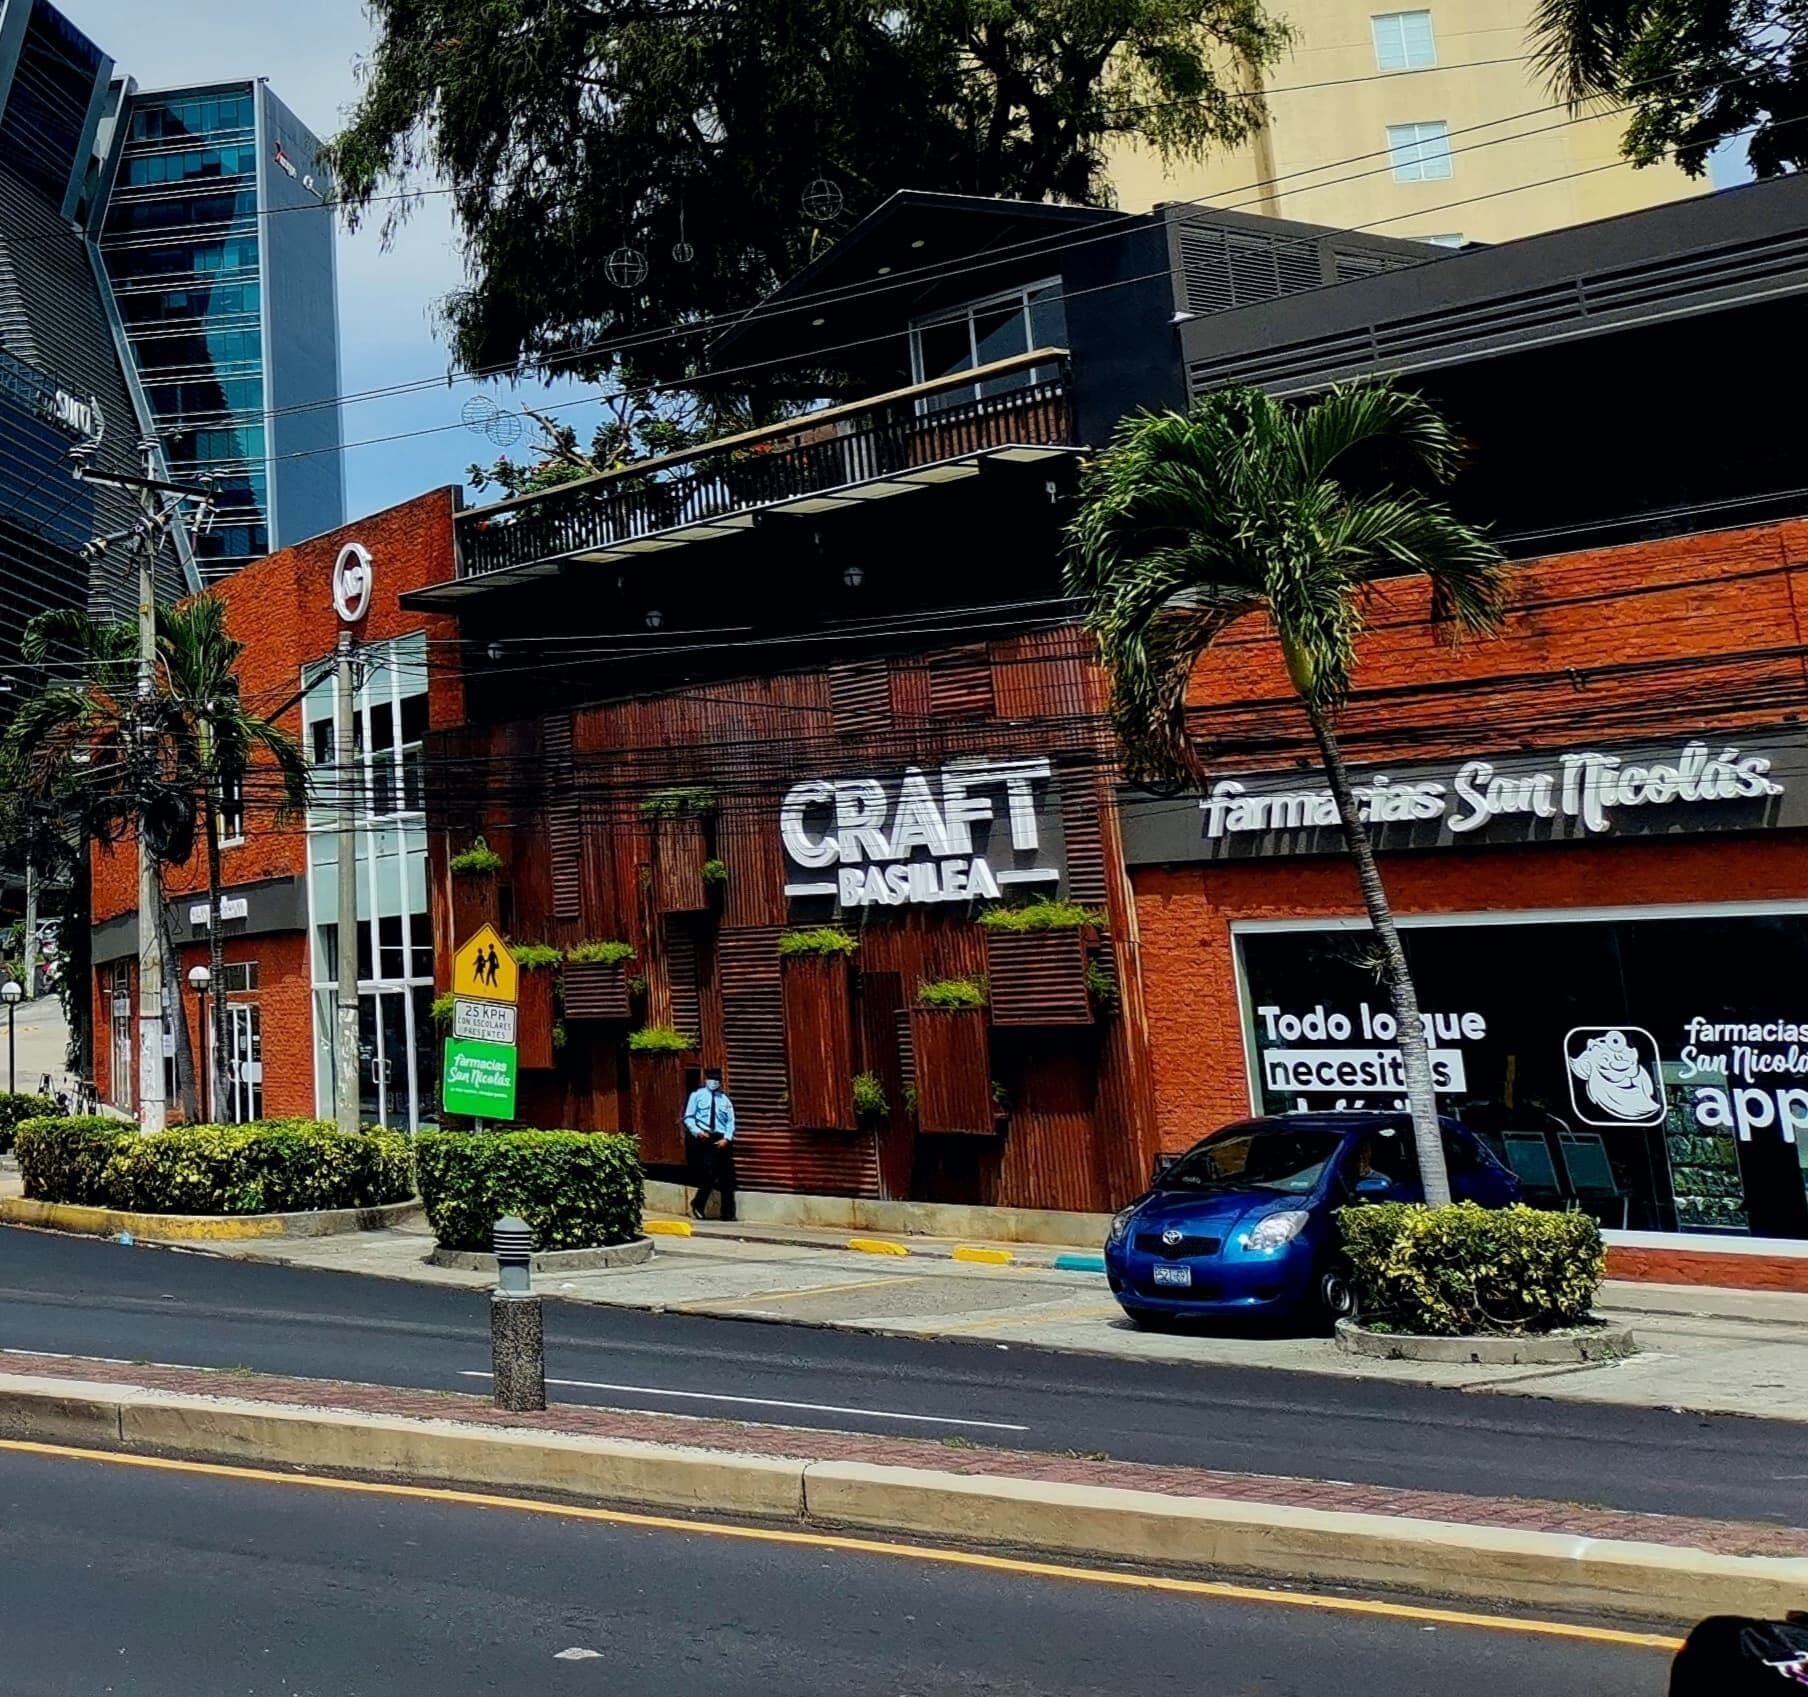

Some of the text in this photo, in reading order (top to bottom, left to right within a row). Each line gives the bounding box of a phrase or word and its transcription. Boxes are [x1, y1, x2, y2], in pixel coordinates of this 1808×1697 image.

[780, 756, 1052, 869] CRAFT
[1447, 761, 1558, 832] San
[837, 856, 1001, 907] BASILEA
[457, 1016, 512, 1031] CON ESCOLARES
[465, 1005, 506, 1020] 25 KPH
[1257, 1004, 1352, 1041] Todo
[1359, 1002, 1397, 1040] lo
[463, 1027, 506, 1040] PRESENTES
[1683, 1016, 1808, 1044] farmacias
[447, 1066, 470, 1083] San
[453, 1053, 508, 1072] farmacias
[1268, 1051, 1452, 1087] necesits
[1678, 1045, 1729, 1079] San
[1694, 1087, 1808, 1143] app
